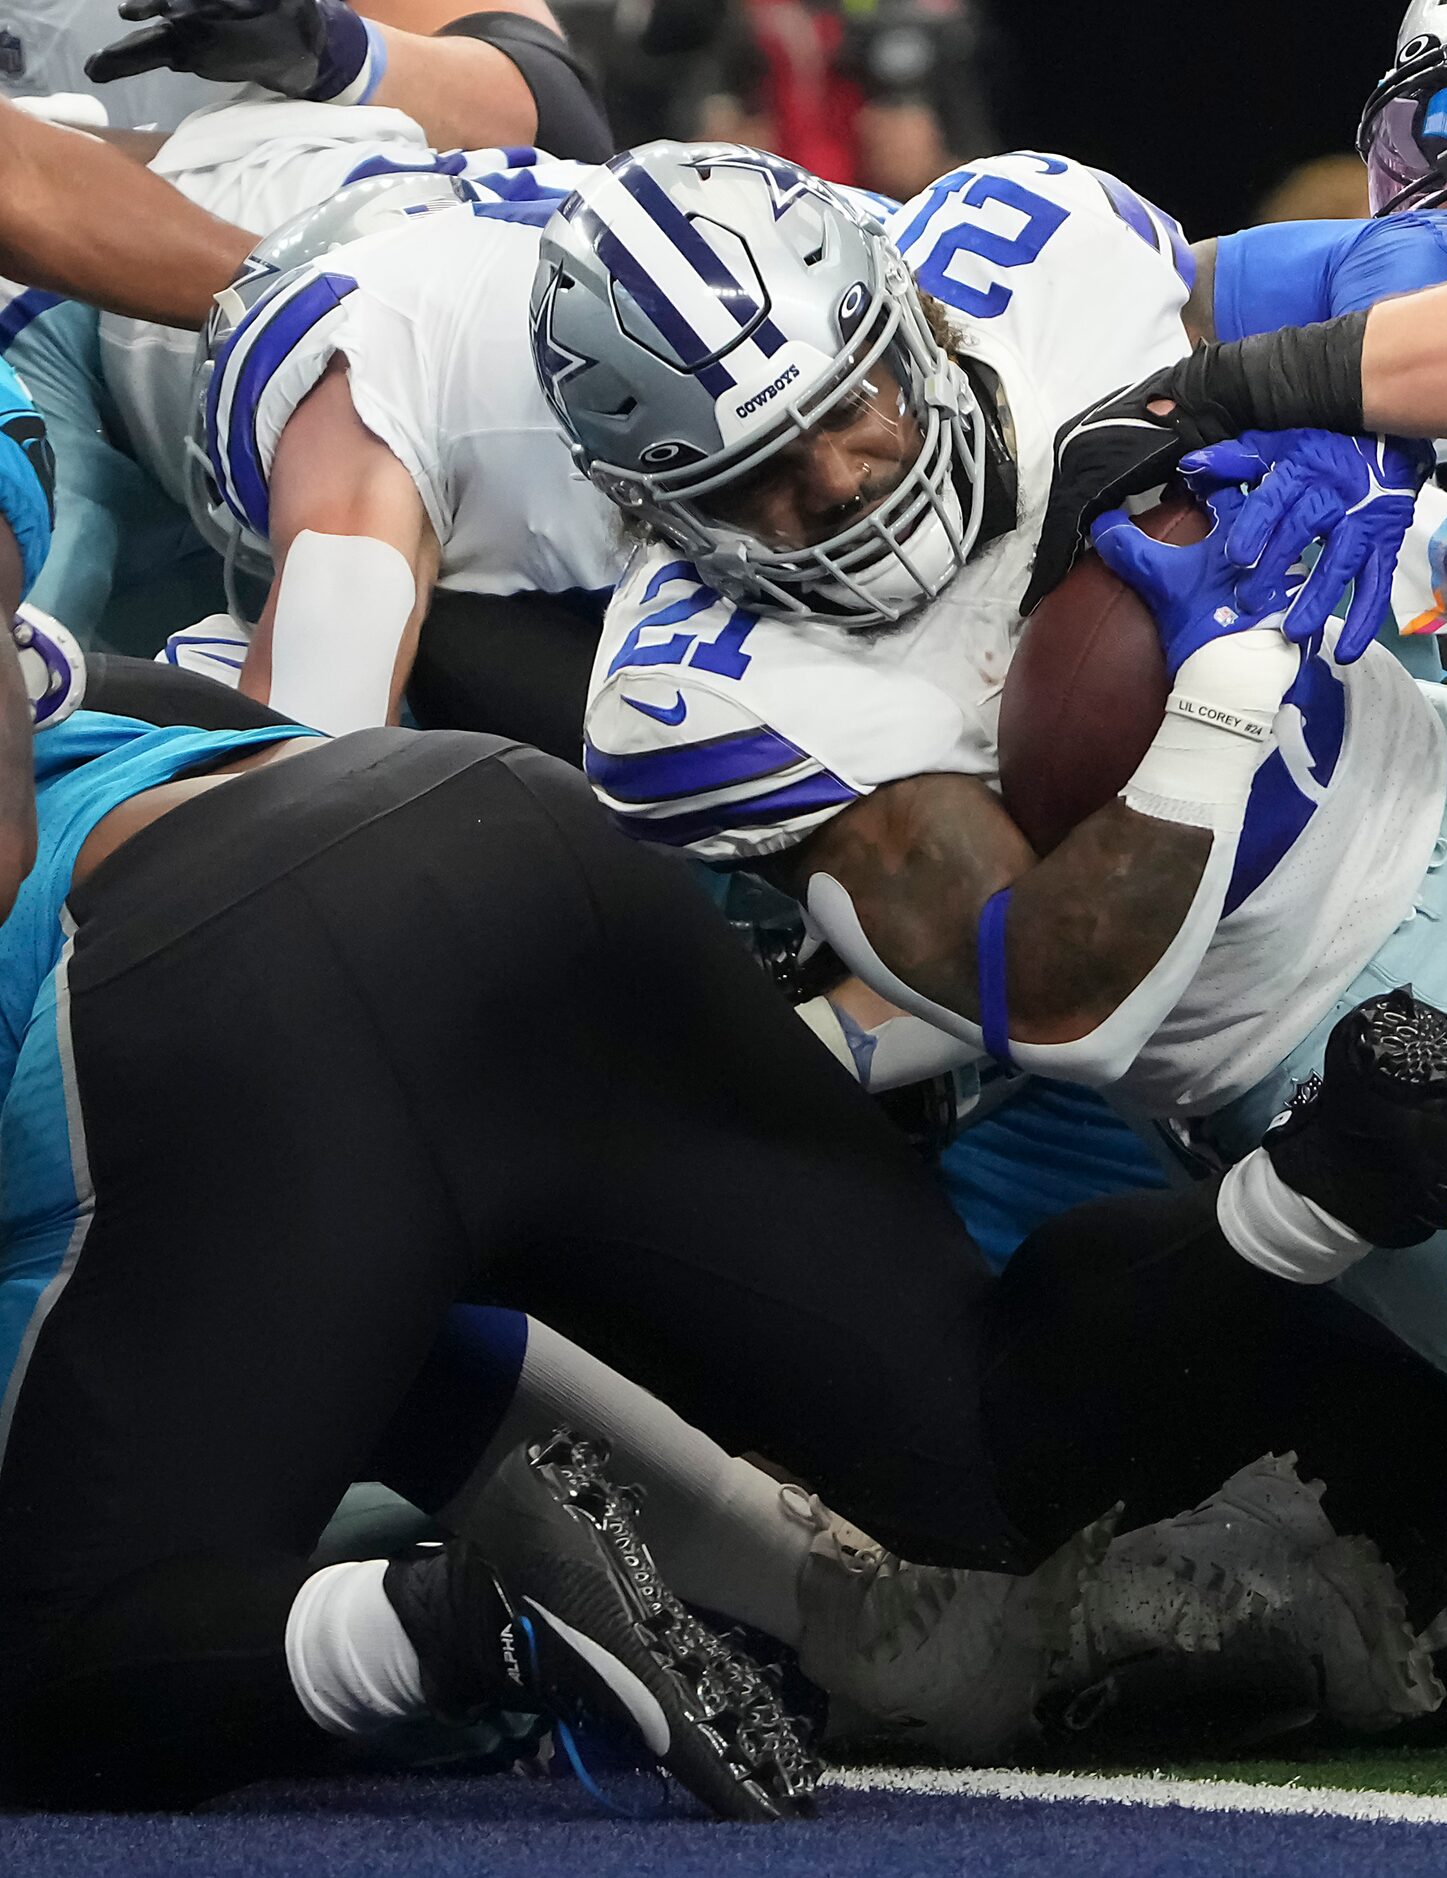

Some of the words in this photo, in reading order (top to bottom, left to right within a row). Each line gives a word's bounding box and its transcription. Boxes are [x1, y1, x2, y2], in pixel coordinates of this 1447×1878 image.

[736, 364, 800, 418] COWBOYS
[607, 560, 760, 681] 21
[1179, 700, 1195, 713] LIL
[1198, 706, 1241, 728] COREY
[1244, 723, 1263, 736] #24
[500, 1623, 525, 1687] ALPHA
